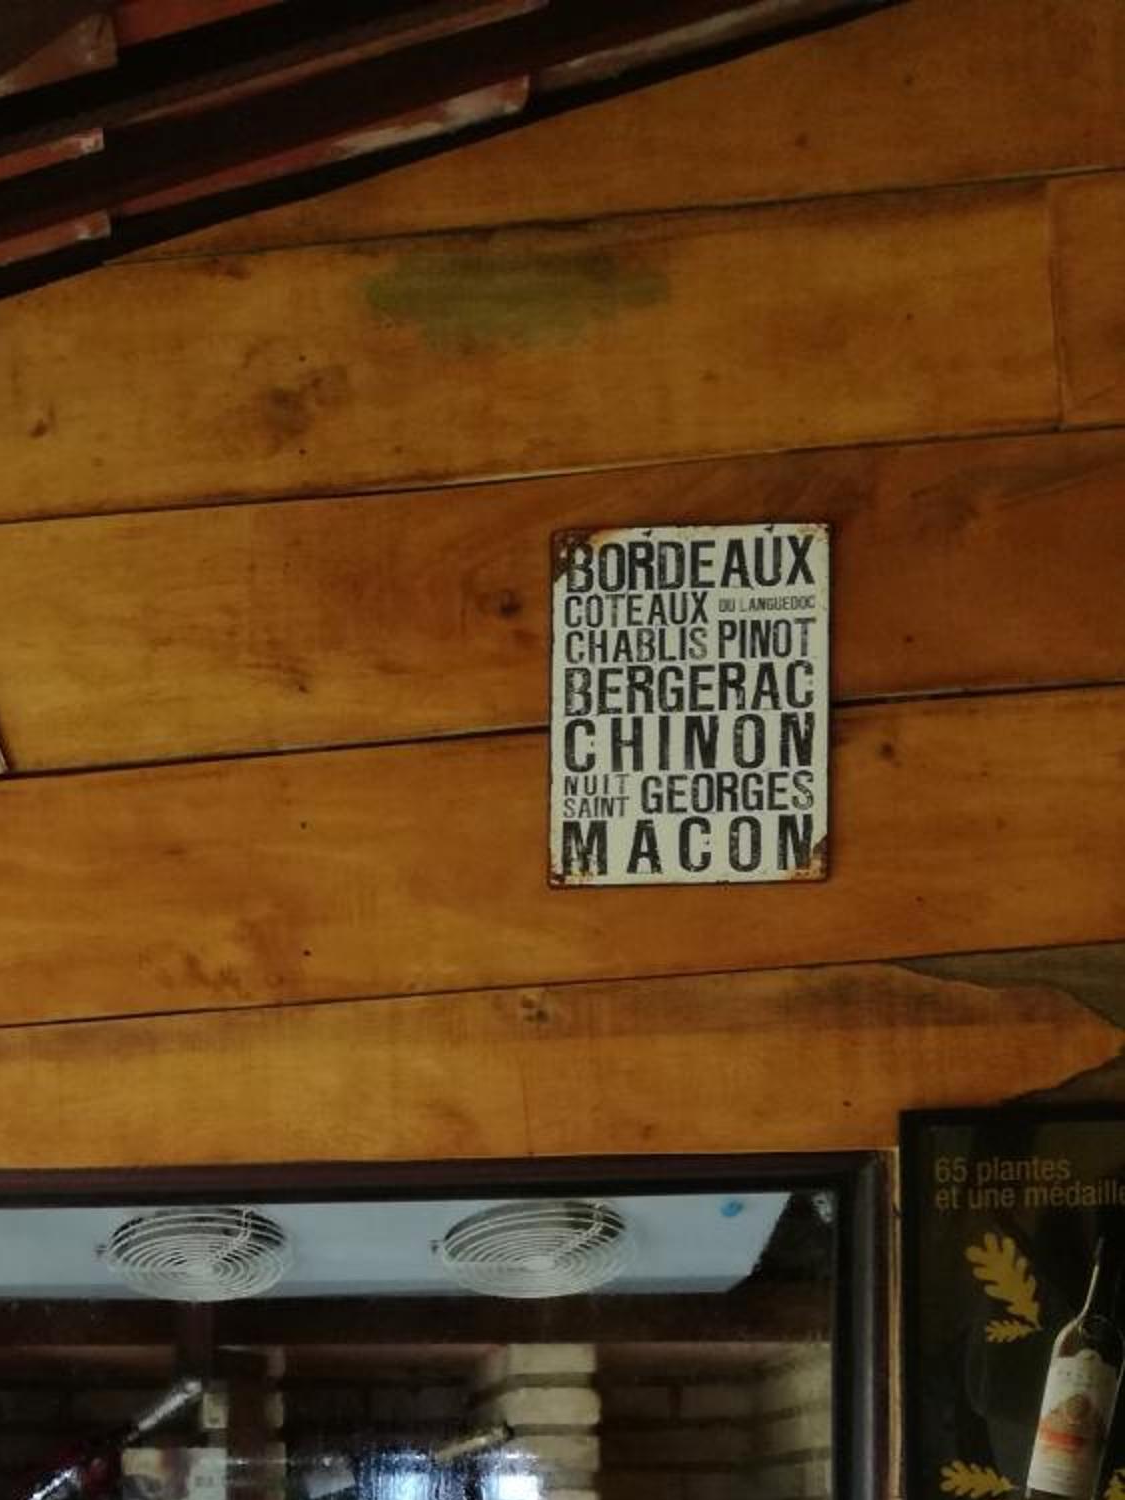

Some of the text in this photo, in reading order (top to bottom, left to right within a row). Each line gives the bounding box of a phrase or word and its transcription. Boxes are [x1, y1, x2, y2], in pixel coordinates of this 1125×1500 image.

[565, 536, 815, 593] BORDEAUX
[564, 592, 708, 628] COTEAUX
[565, 617, 816, 663] CHABLIS PINOT
[564, 660, 813, 716] BERGERAC
[564, 712, 814, 773] CHINON
[563, 796, 629, 818] SAINT
[564, 774, 629, 796] NUIT
[641, 770, 814, 814] GEORGES
[562, 814, 813, 876] MACON
[935, 1156, 1071, 1187] 65 plantes
[936, 1187, 958, 1210] et
[968, 1186, 1016, 1210] une
